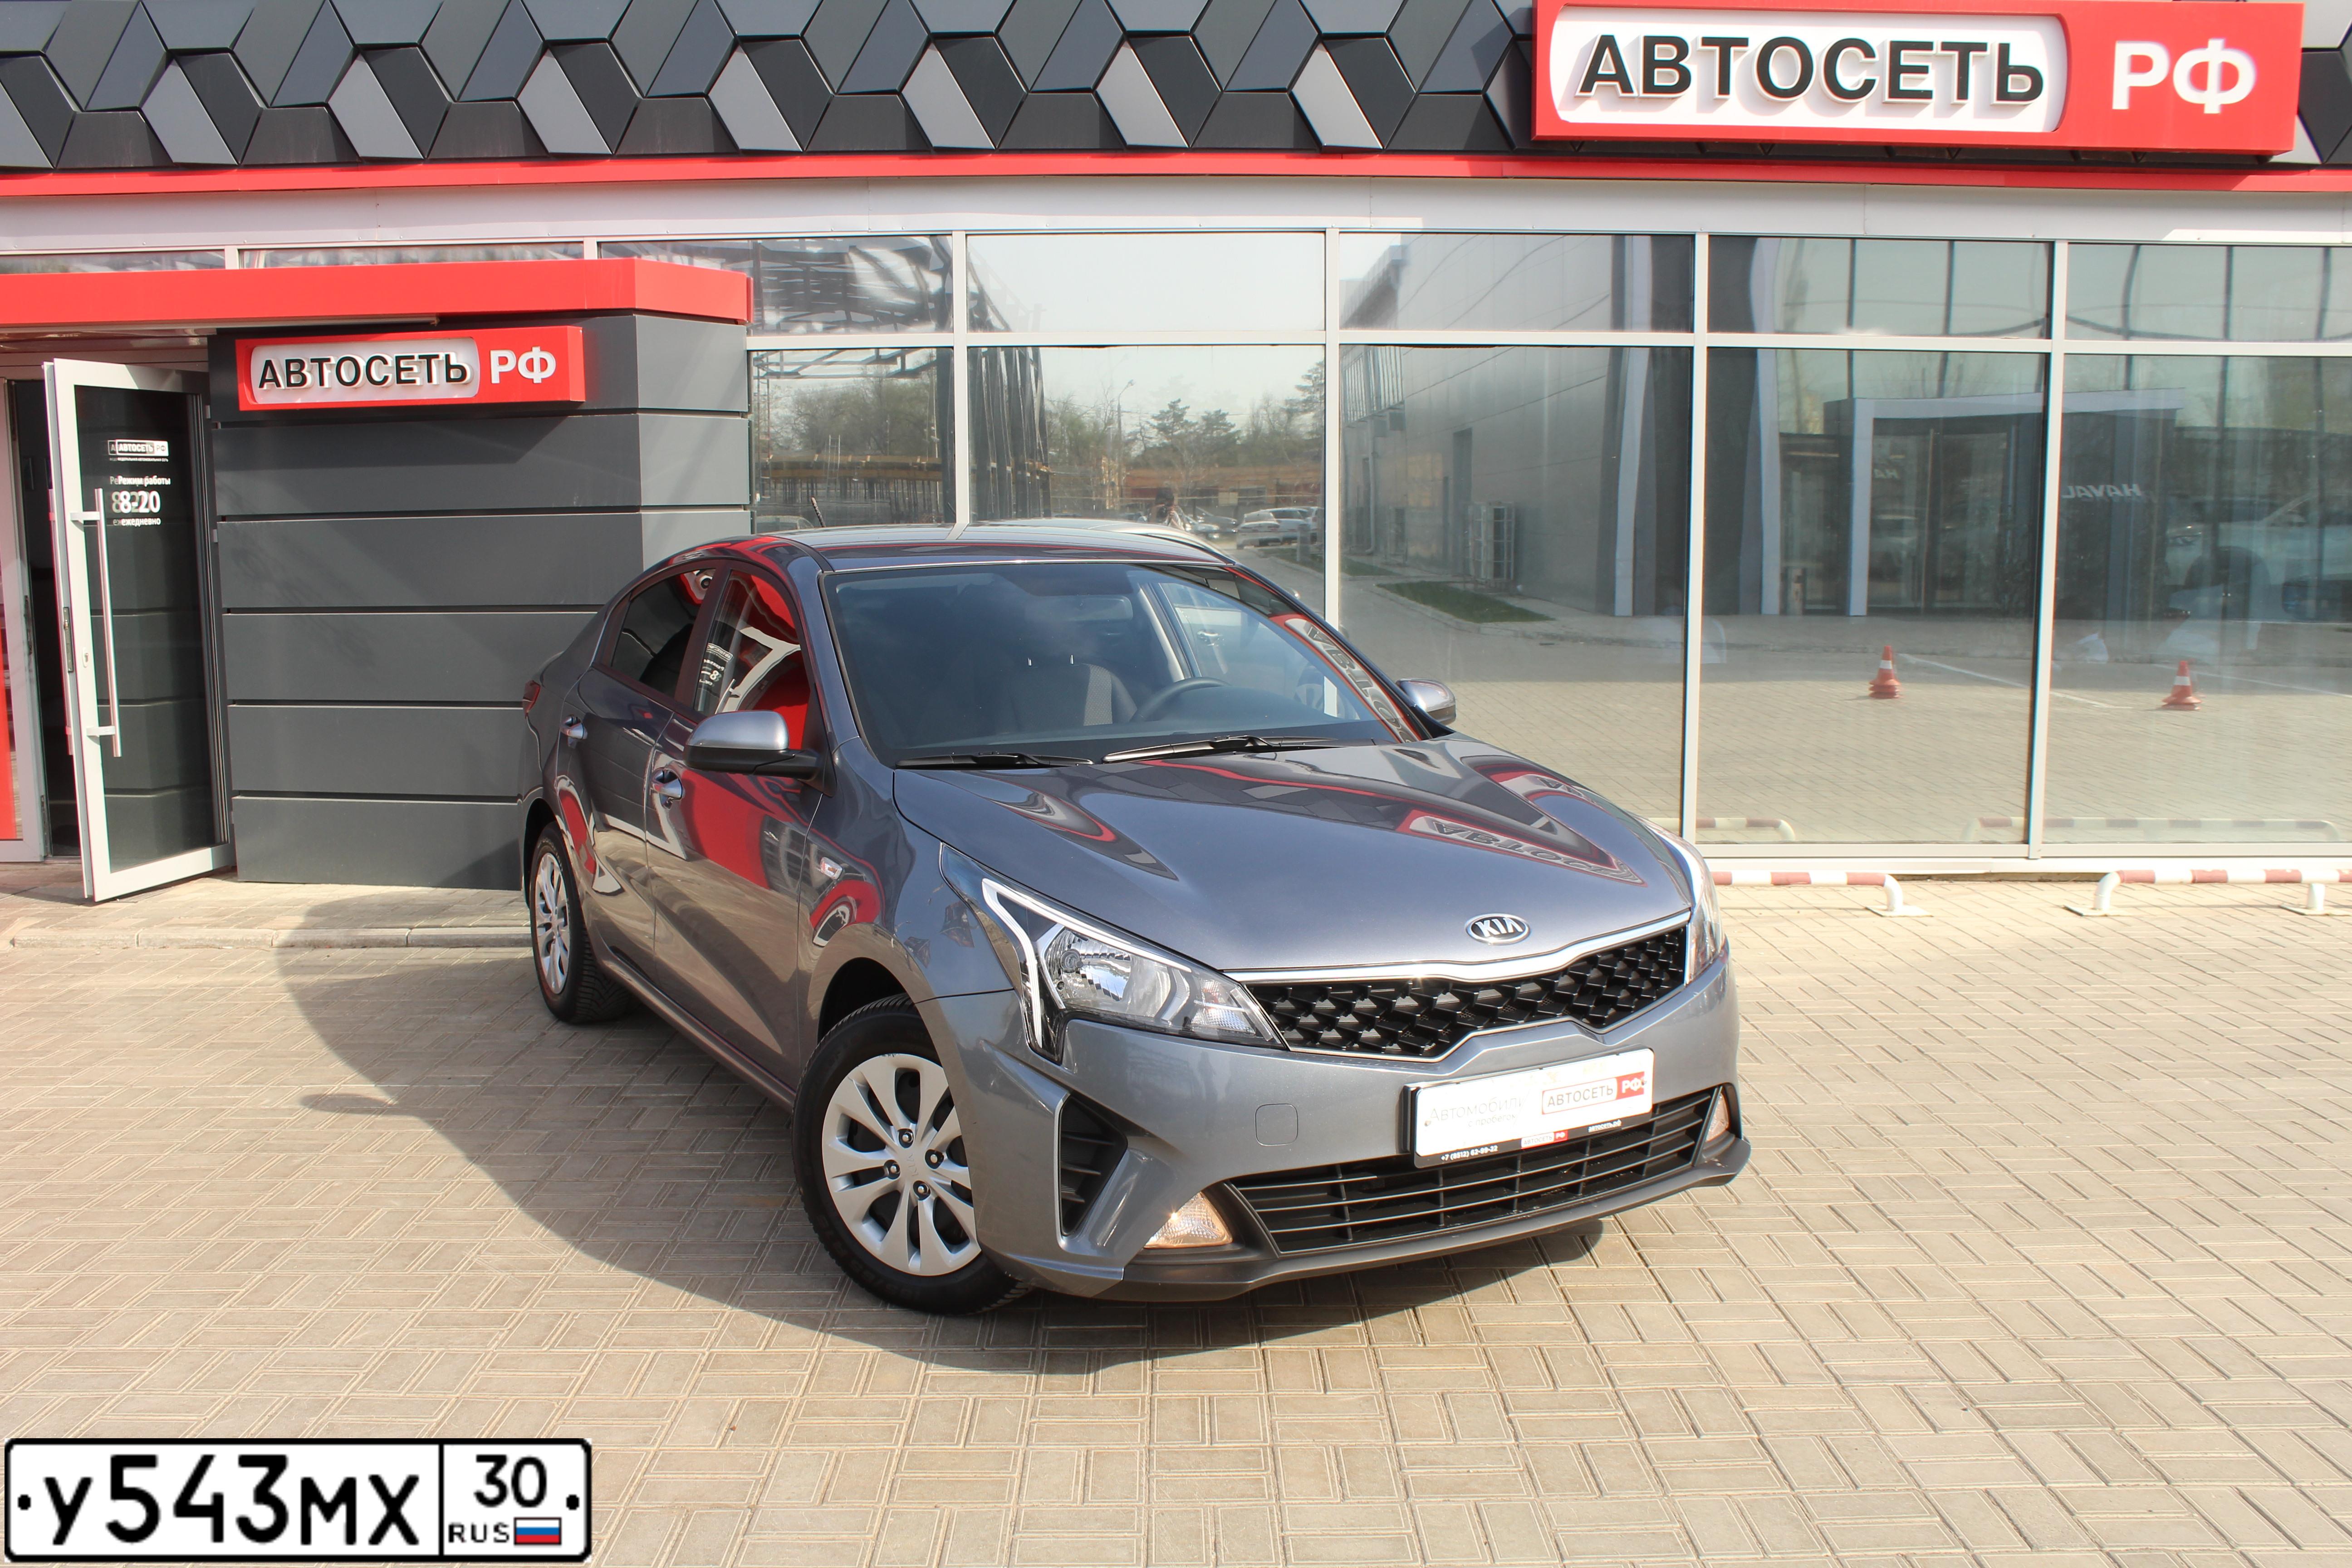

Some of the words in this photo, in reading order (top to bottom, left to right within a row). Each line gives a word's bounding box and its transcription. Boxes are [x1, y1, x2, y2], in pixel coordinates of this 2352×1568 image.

[1581, 34, 2043, 104] АВТОСЕТЬ
[2111, 38, 2256, 114] РФ
[258, 353, 469, 389] АВТОСЕТЬ
[490, 346, 556, 384] РФ
[119, 443, 153, 452] АВТОСЕТЬ
[118, 476, 143, 485] Режим
[144, 475, 171, 487] работы
[121, 518, 161, 527] ежедневно
[1475, 917, 1524, 937] KIA
[1547, 1085, 1613, 1107] АВТОСЕТЬ
[1621, 1076, 1643, 1094] РФ
[1430, 1097, 1524, 1121] Автомобили
[1524, 1135, 1553, 1145] АВТОСЕТЬ
[1555, 1131, 1566, 1139] РФ
[1441, 1153, 1449, 1161] +7
